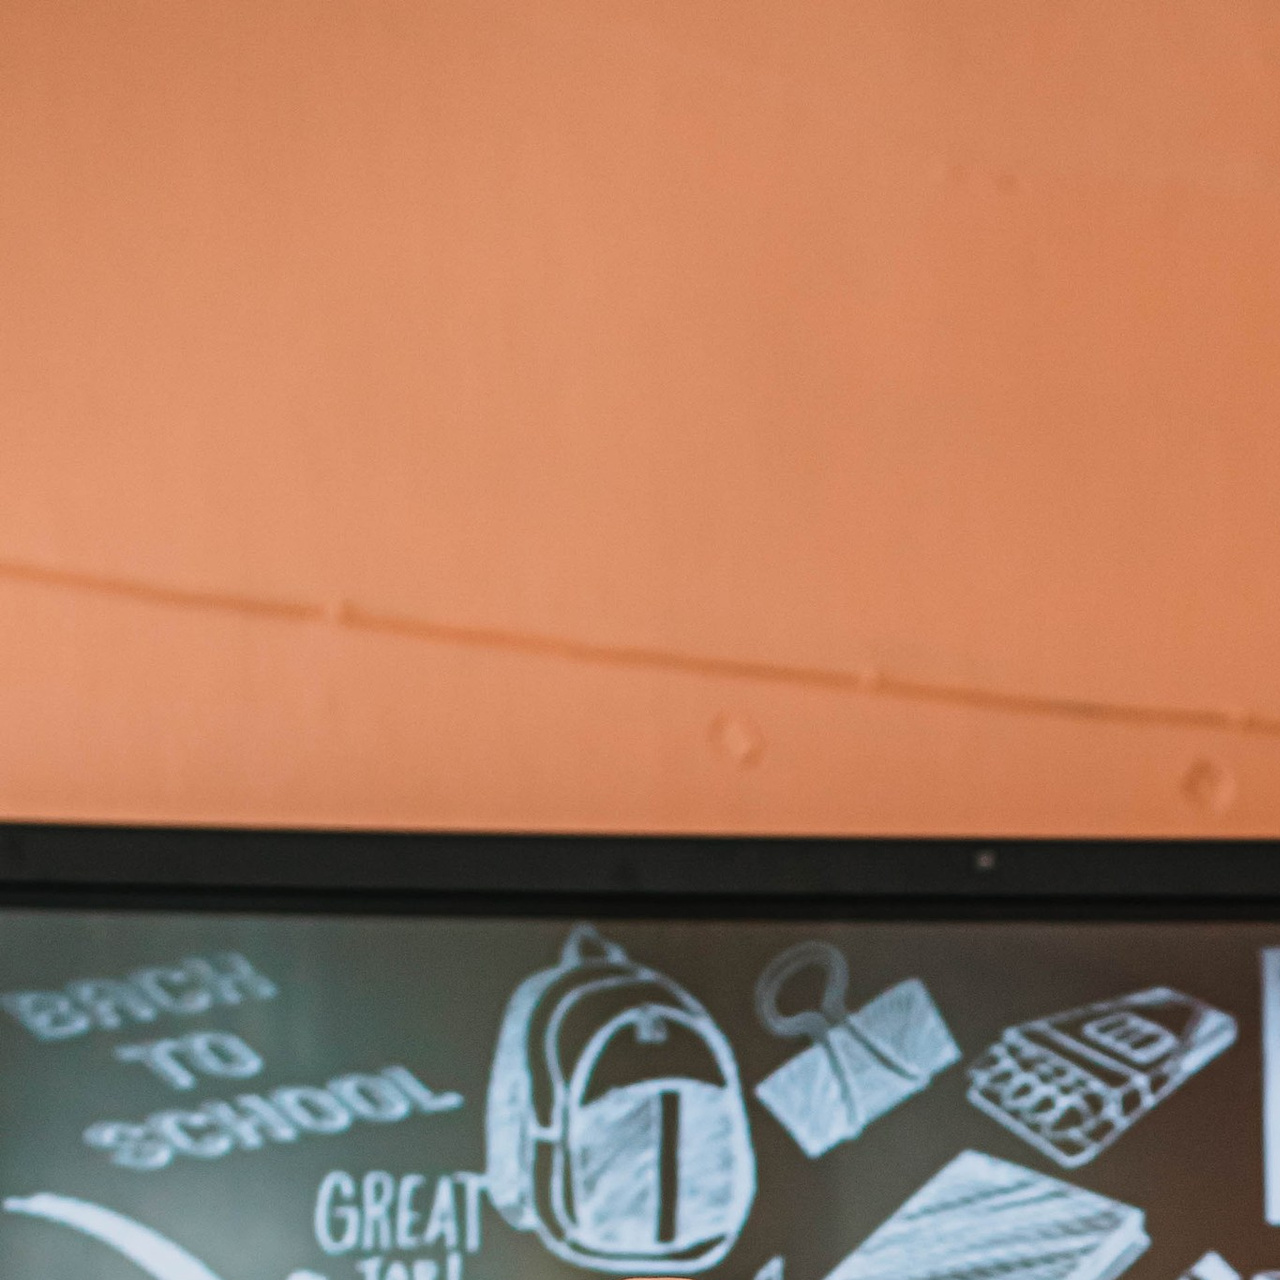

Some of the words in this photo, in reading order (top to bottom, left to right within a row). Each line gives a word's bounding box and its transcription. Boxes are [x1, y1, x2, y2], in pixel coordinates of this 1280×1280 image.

[112, 1030, 263, 1090] TO
[83, 1066, 465, 1170] SCHOOL
[314, 1169, 490, 1256] GREAT
